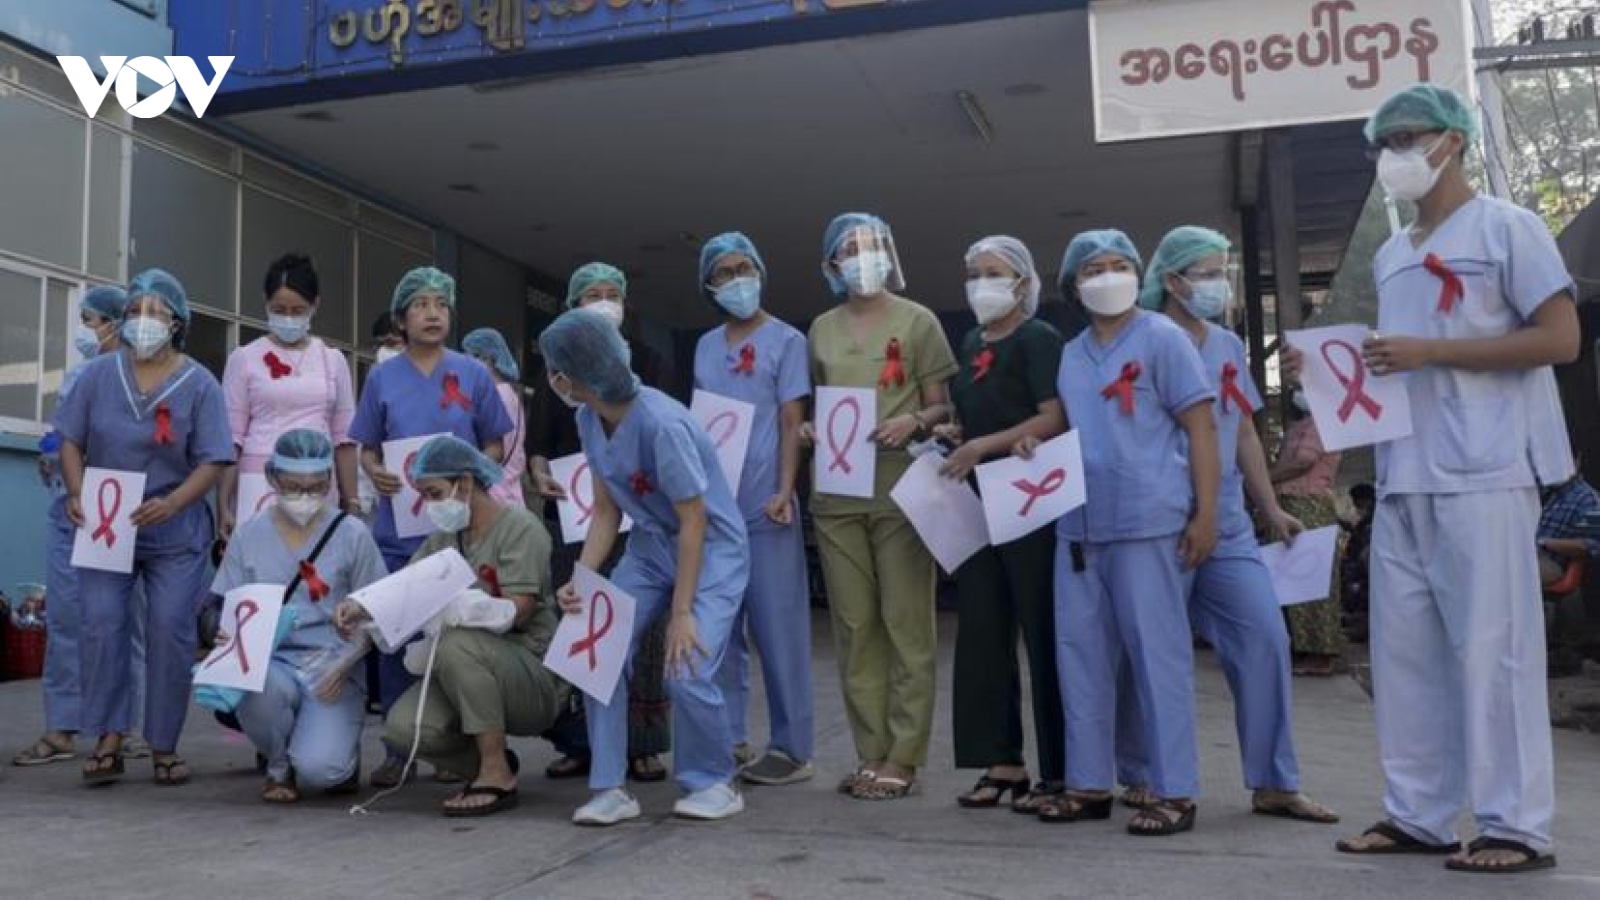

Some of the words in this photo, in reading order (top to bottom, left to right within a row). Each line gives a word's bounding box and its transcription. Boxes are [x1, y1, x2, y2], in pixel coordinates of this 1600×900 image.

[1119, 0, 1438, 99] အရေးပေါ်ဌာန
